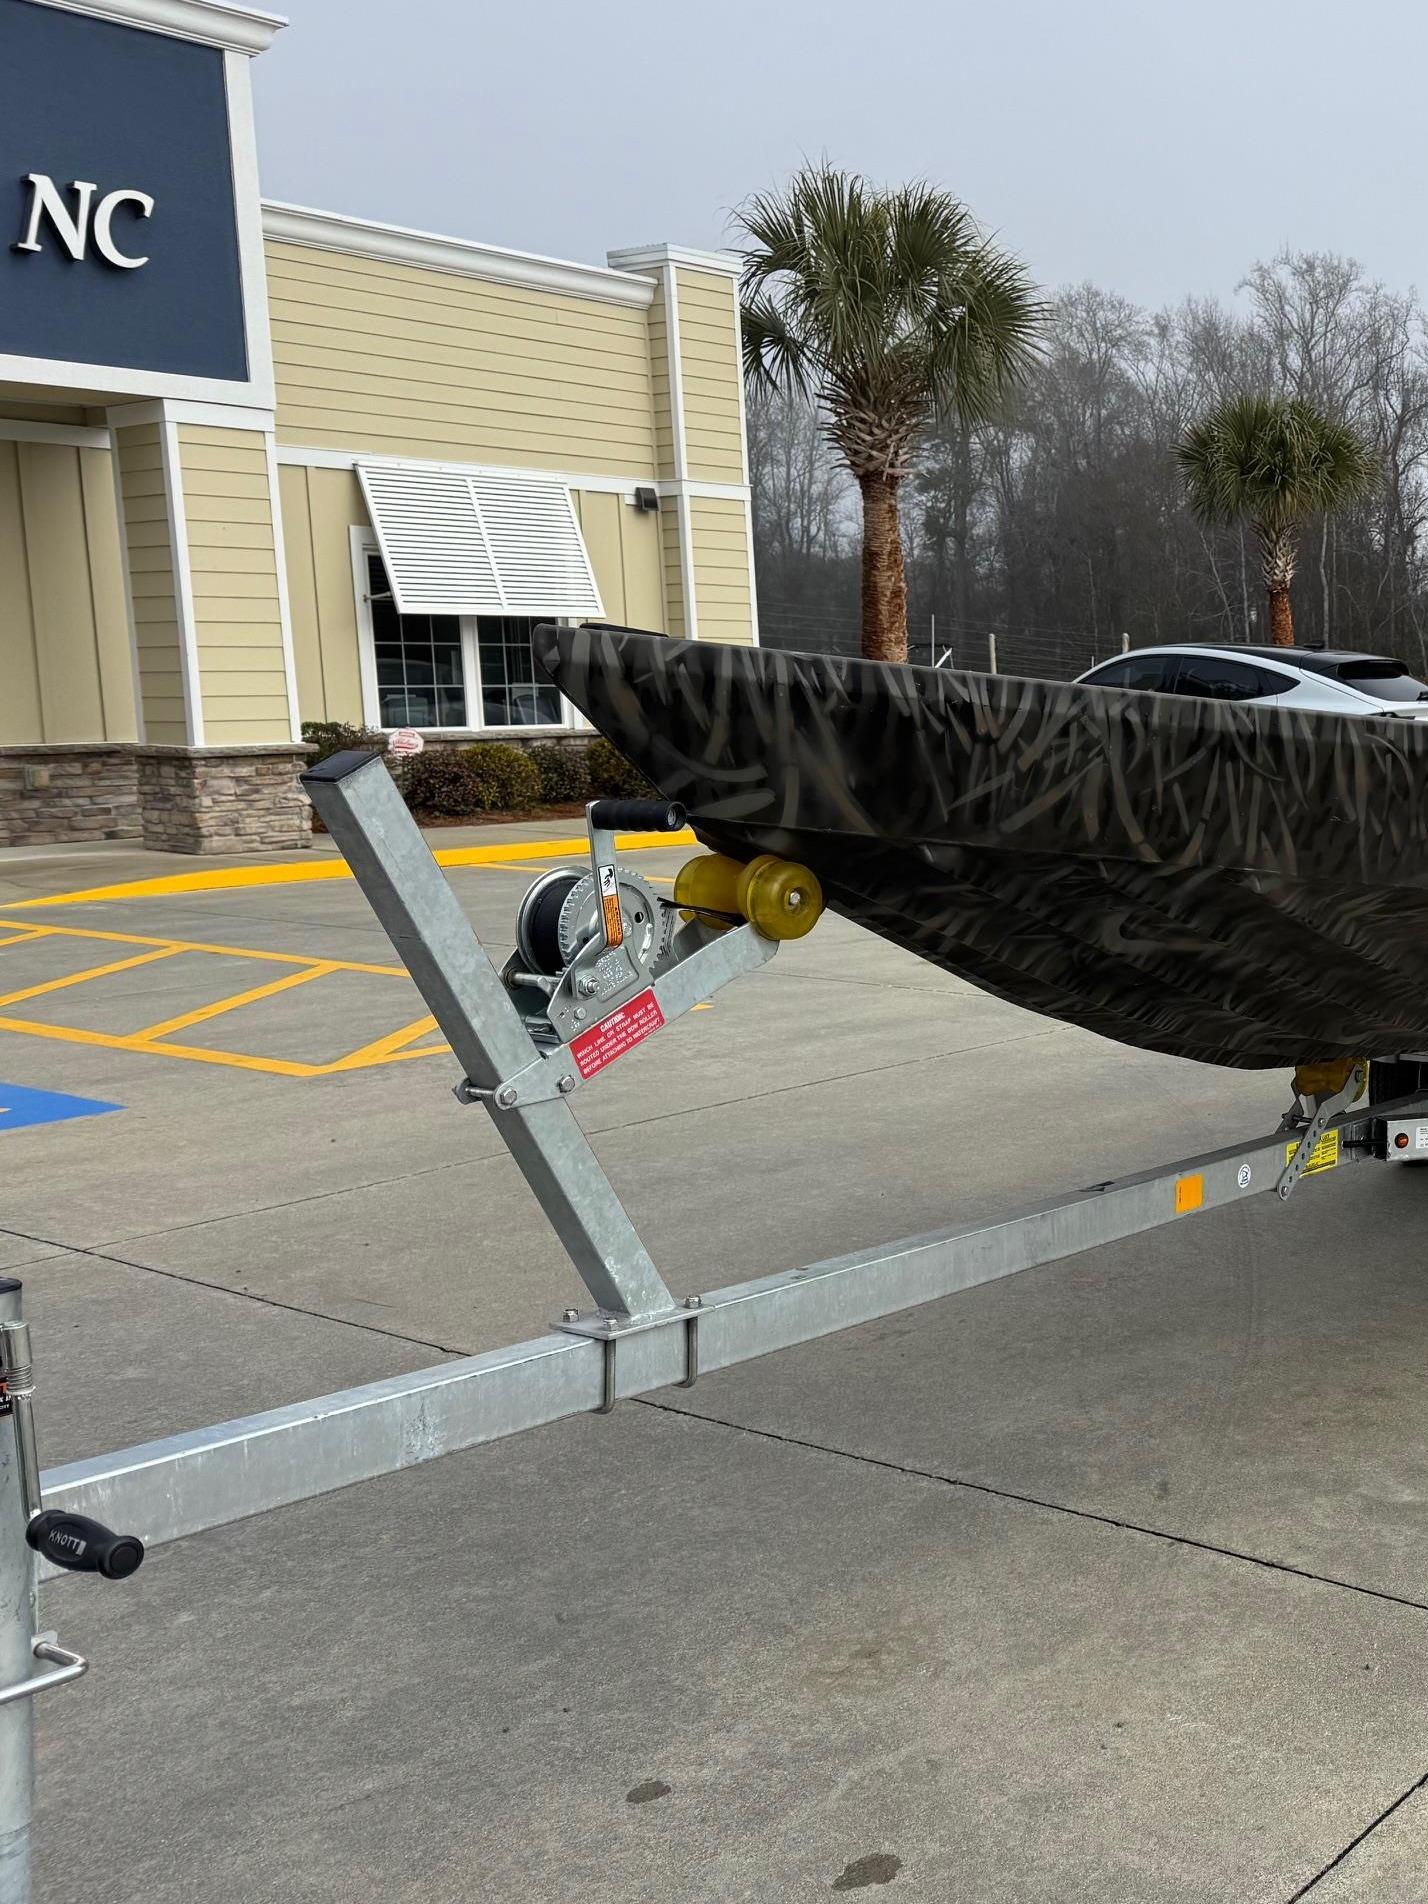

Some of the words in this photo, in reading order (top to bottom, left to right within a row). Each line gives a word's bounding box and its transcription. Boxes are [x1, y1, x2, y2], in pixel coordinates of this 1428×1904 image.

[12, 173, 155, 270] NC
[580, 1050, 599, 1067] ROUTED
[600, 1037, 617, 1053] UNDER
[617, 1030, 627, 1041] THE
[627, 1022, 639, 1034] BOW
[639, 1009, 658, 1026] ROLLER
[583, 1058, 602, 1075] BEFORE
[602, 1041, 627, 1062] ATTACHING
[626, 1036, 633, 1044] TO
[632, 1016, 660, 1040] WATERCRAFT
[594, 1036, 606, 1048] LINE
[606, 1029, 615, 1039] OR
[616, 1017, 631, 1032] STRAP
[633, 1007, 646, 1020] MUST
[647, 1002, 655, 1010] BE
[49, 1529, 79, 1551] KNOTT
